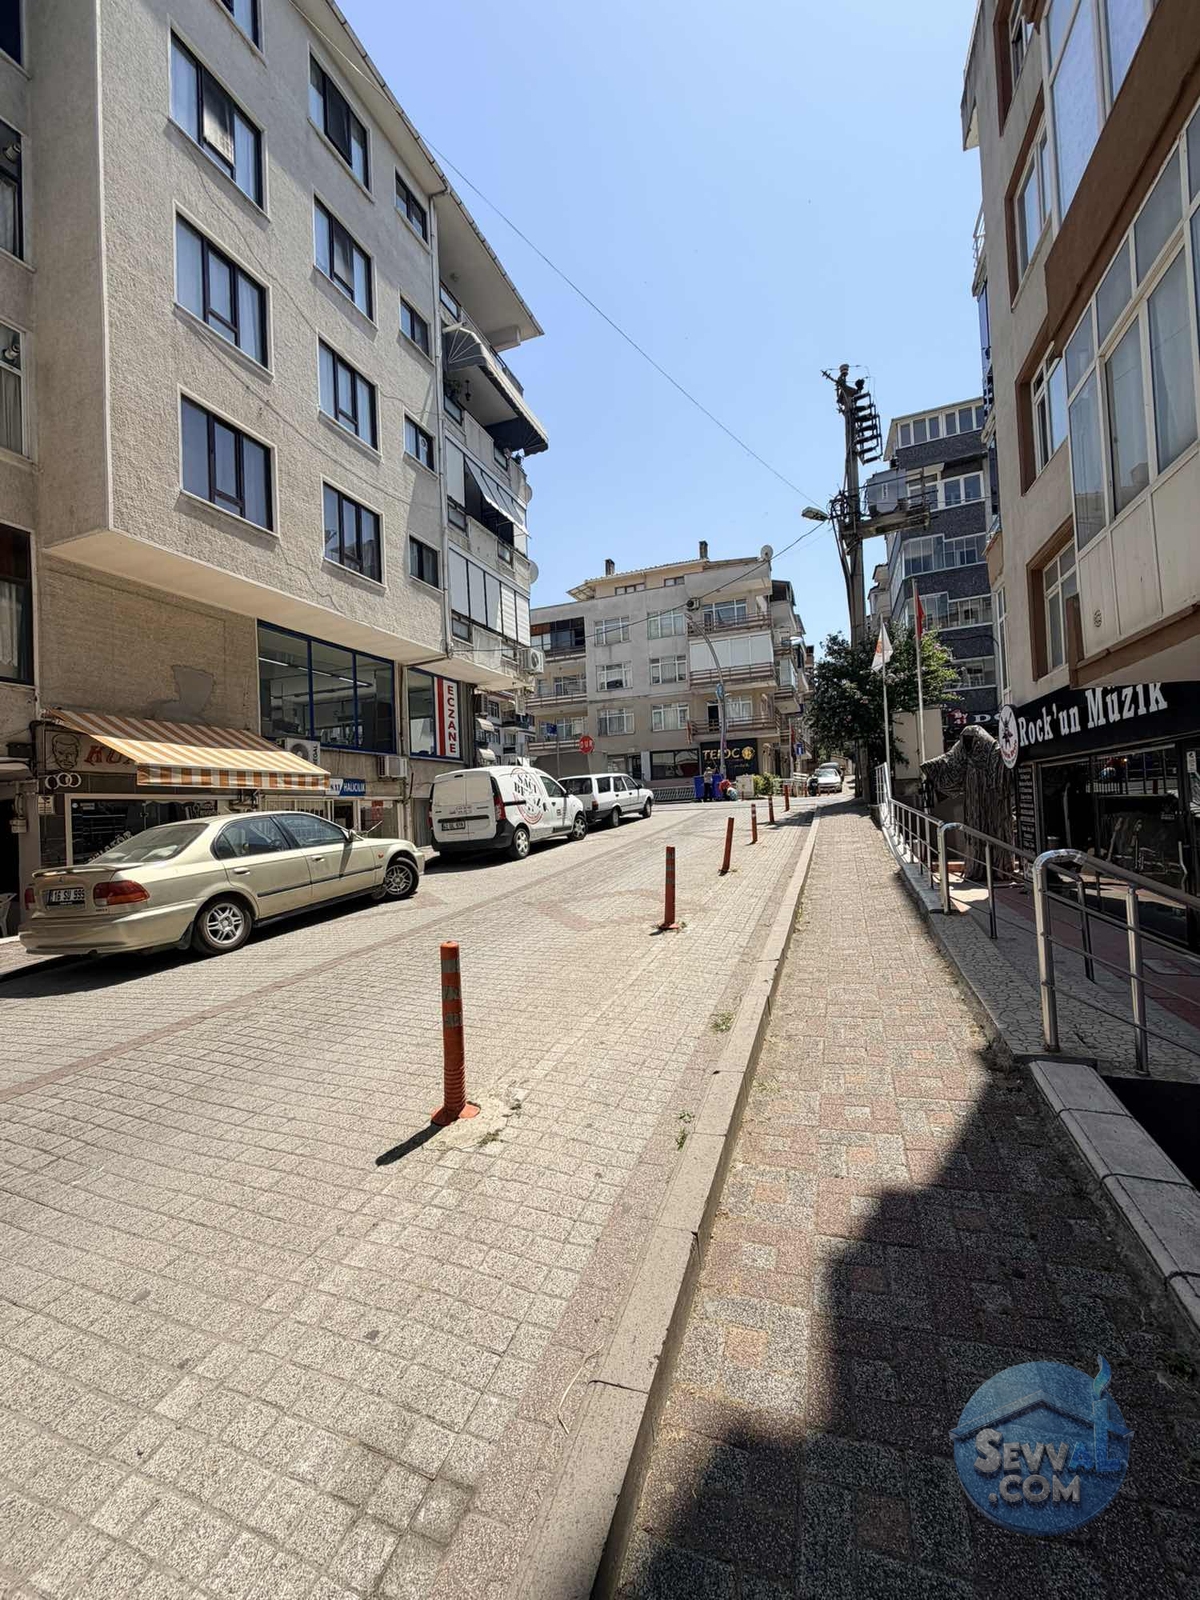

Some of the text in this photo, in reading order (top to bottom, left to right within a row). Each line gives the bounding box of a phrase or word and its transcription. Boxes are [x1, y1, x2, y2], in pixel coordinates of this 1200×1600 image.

[447, 685, 457, 753] ECZANE
[1018, 703, 1081, 748] Rock'un
[84, 745, 131, 766] KU
